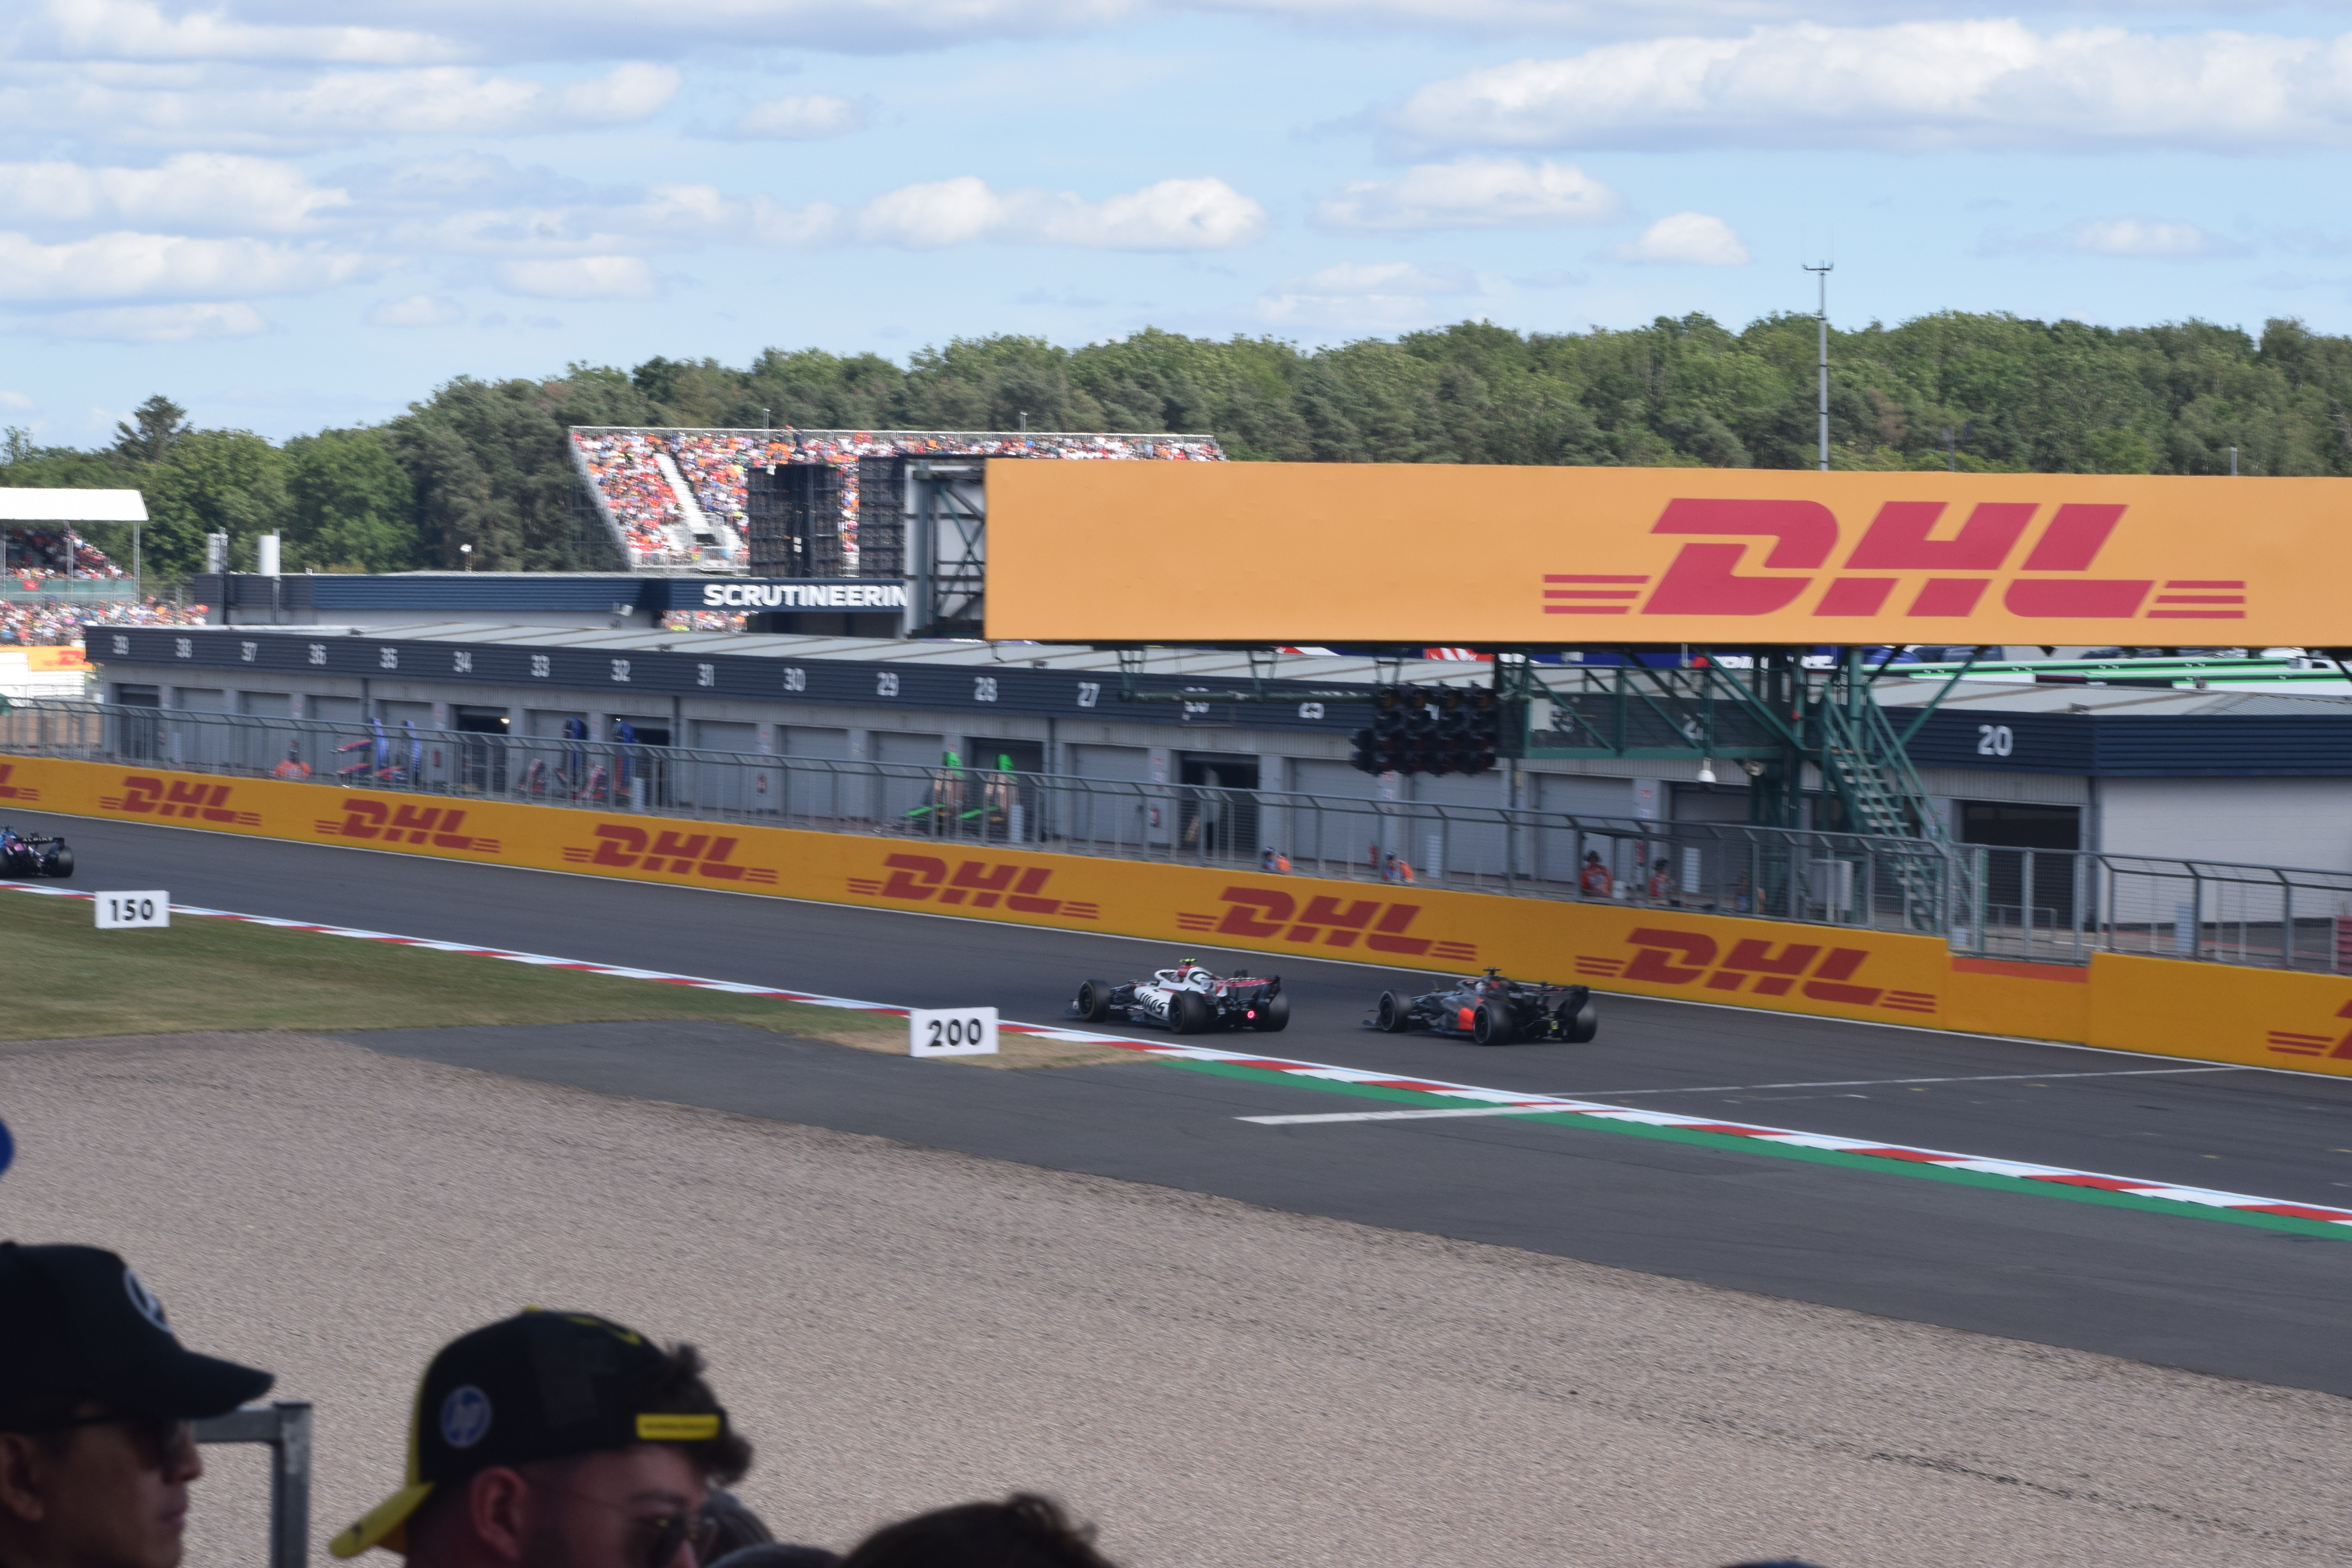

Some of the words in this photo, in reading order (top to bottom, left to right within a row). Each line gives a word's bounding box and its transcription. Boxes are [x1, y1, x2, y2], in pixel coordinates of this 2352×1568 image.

[1640, 498, 2156, 618] DHL
[703, 584, 907, 606] SCRUTINEERIN
[113, 635, 129, 655] 39
[175, 638, 192, 659] 38
[241, 641, 258, 662] 37
[308, 644, 327, 665] 36
[380, 647, 397, 669] 35
[454, 651, 472, 673] 34
[531, 655, 550, 677] 33
[611, 659, 631, 682] 32
[697, 663, 714, 687] 31
[784, 668, 806, 692] 30
[877, 671, 899, 697] 29
[974, 677, 998, 702] 28
[1077, 682, 1100, 707] 27
[1977, 725, 2013, 757] 20
[122, 776, 237, 822] DHL
[341, 799, 472, 849] DHL
[592, 824, 745, 880] DHL
[880, 853, 1061, 914] DHL
[110, 899, 153, 921] 150
[1216, 886, 1432, 955] DHL
[1622, 927, 1883, 1006] DHL
[926, 1018, 982, 1047] 200
